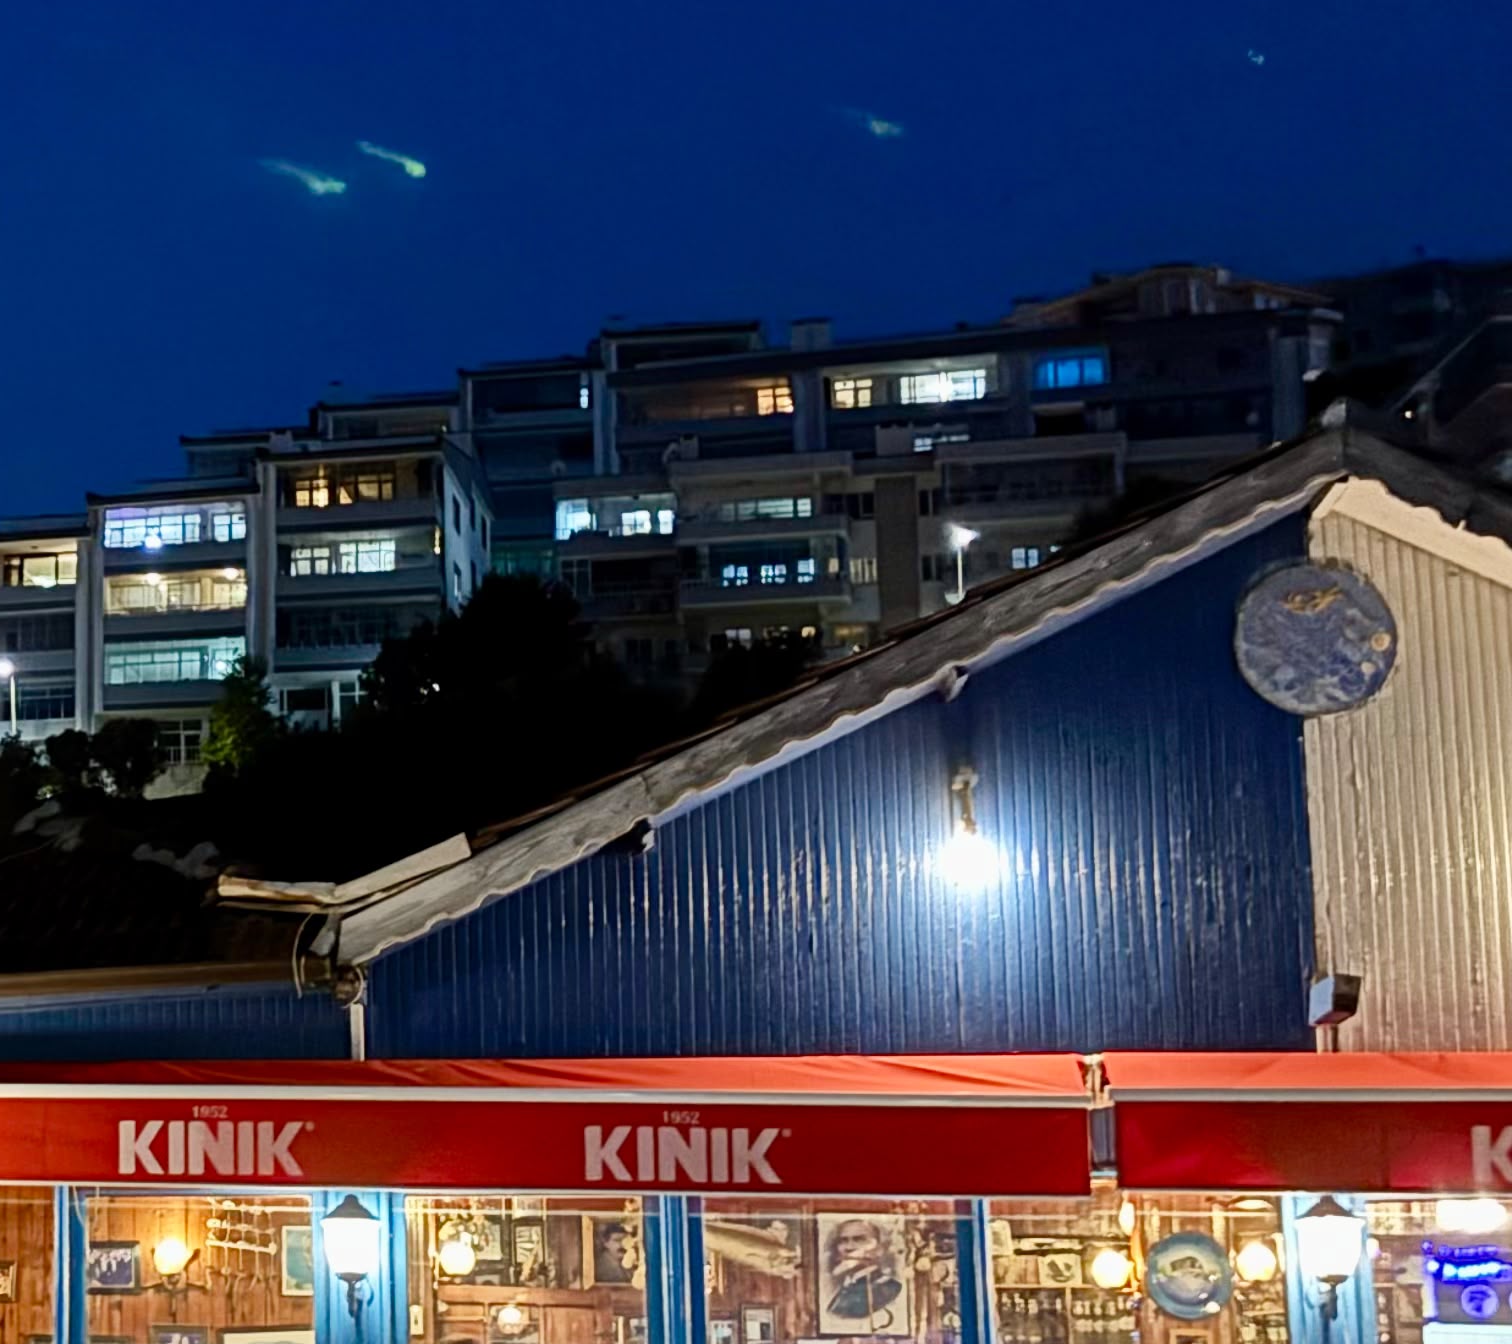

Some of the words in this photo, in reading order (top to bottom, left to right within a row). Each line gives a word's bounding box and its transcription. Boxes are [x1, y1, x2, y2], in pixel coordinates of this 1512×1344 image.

[191, 1105, 228, 1119] 1952
[663, 1110, 701, 1125] 1952
[117, 1120, 305, 1176] KINIK
[583, 1124, 783, 1184] KINIK
